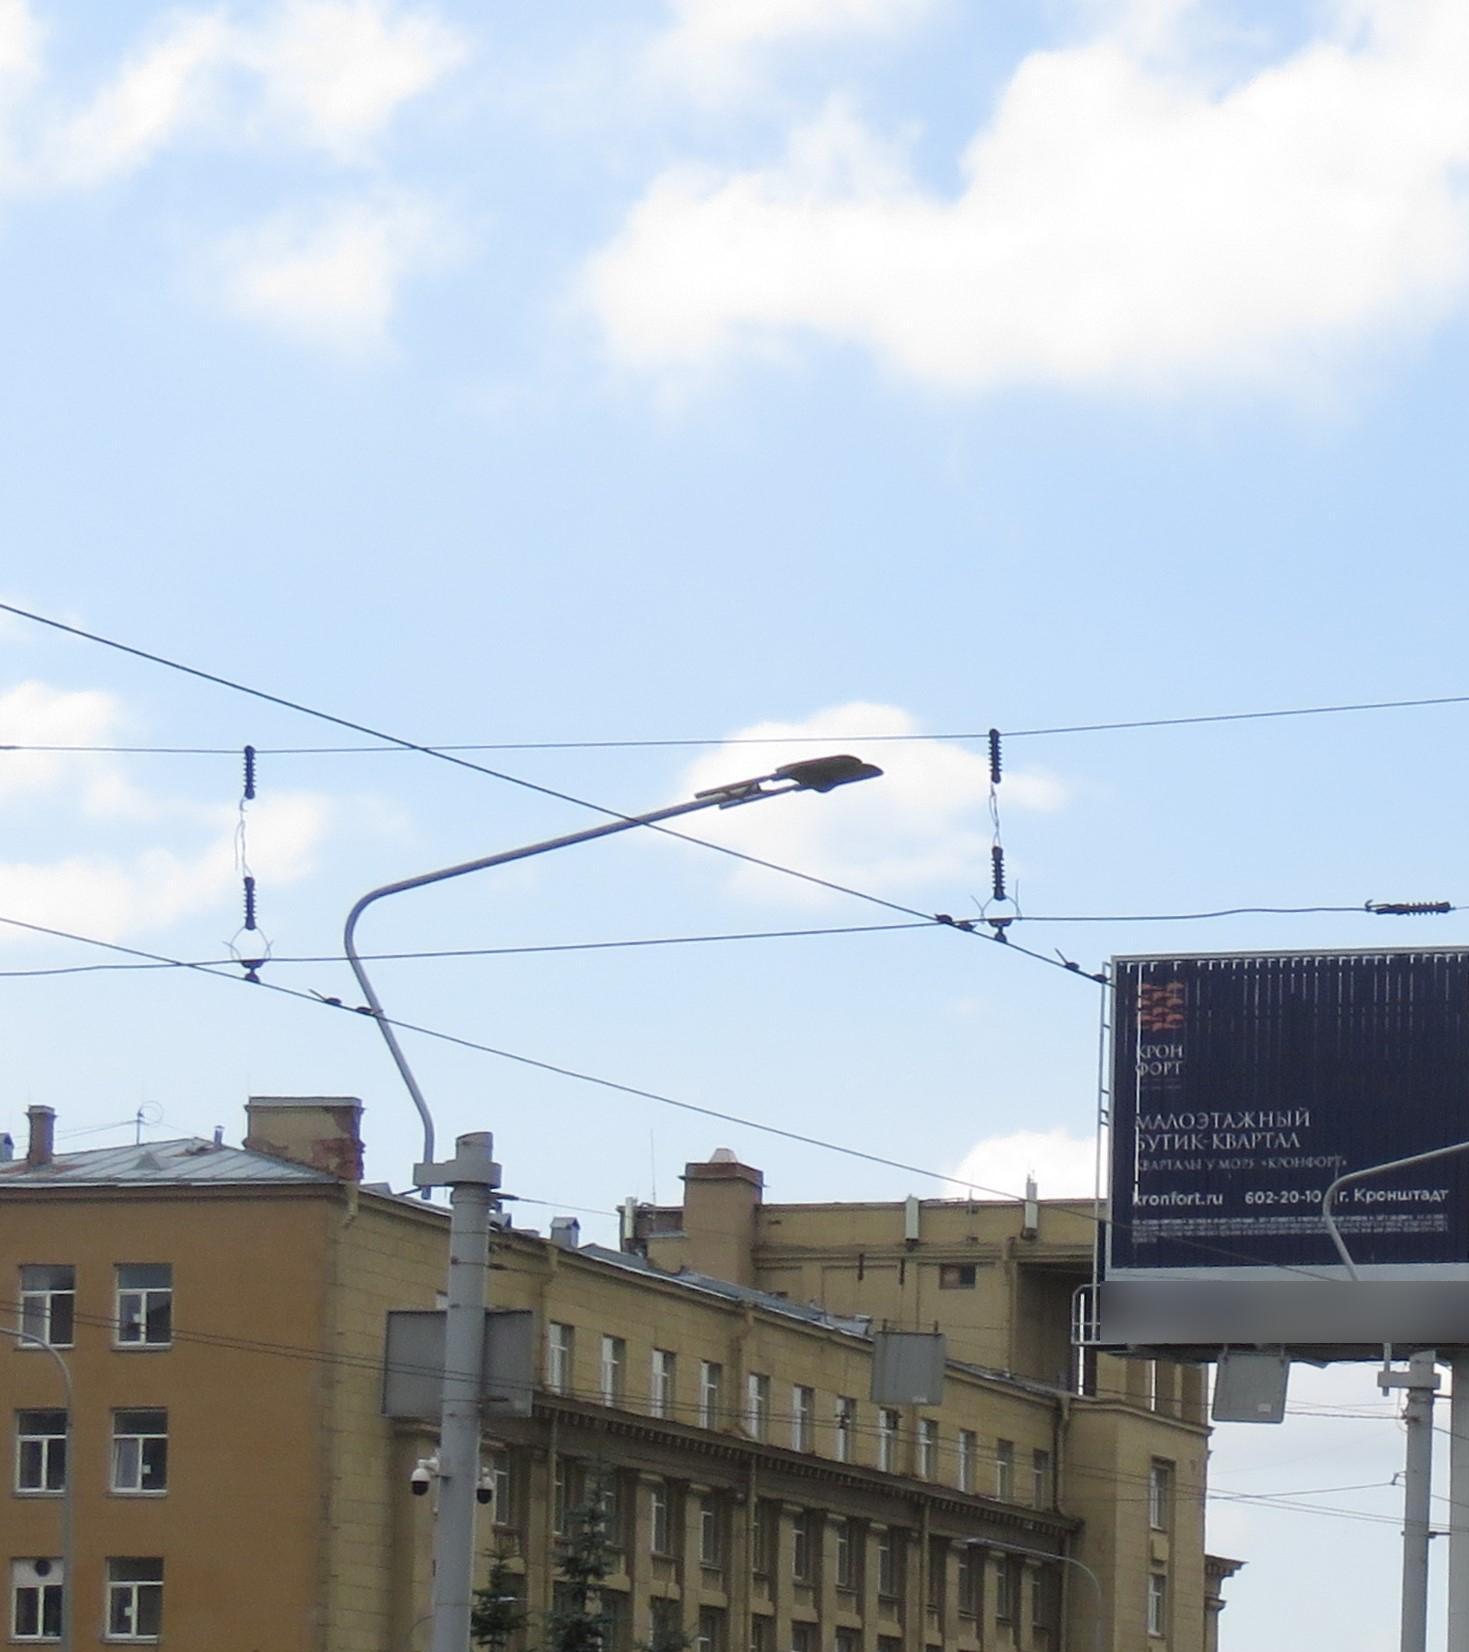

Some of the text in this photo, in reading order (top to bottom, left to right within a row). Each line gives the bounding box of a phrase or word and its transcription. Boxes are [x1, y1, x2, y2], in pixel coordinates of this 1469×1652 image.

[1136, 1043, 1183, 1059] КРОН
[1135, 1061, 1183, 1076] ФОРТ
[1135, 1107, 1311, 1130] МАЛОЭТАЖНЫЙ
[1136, 1132, 1301, 1152] БУТИК-КВАРТАЛ
[1132, 1189, 1224, 1206] kronfort.ru
[1244, 1189, 1322, 1205] 602-20-10
[1354, 1187, 1449, 1204] Кронштадт
